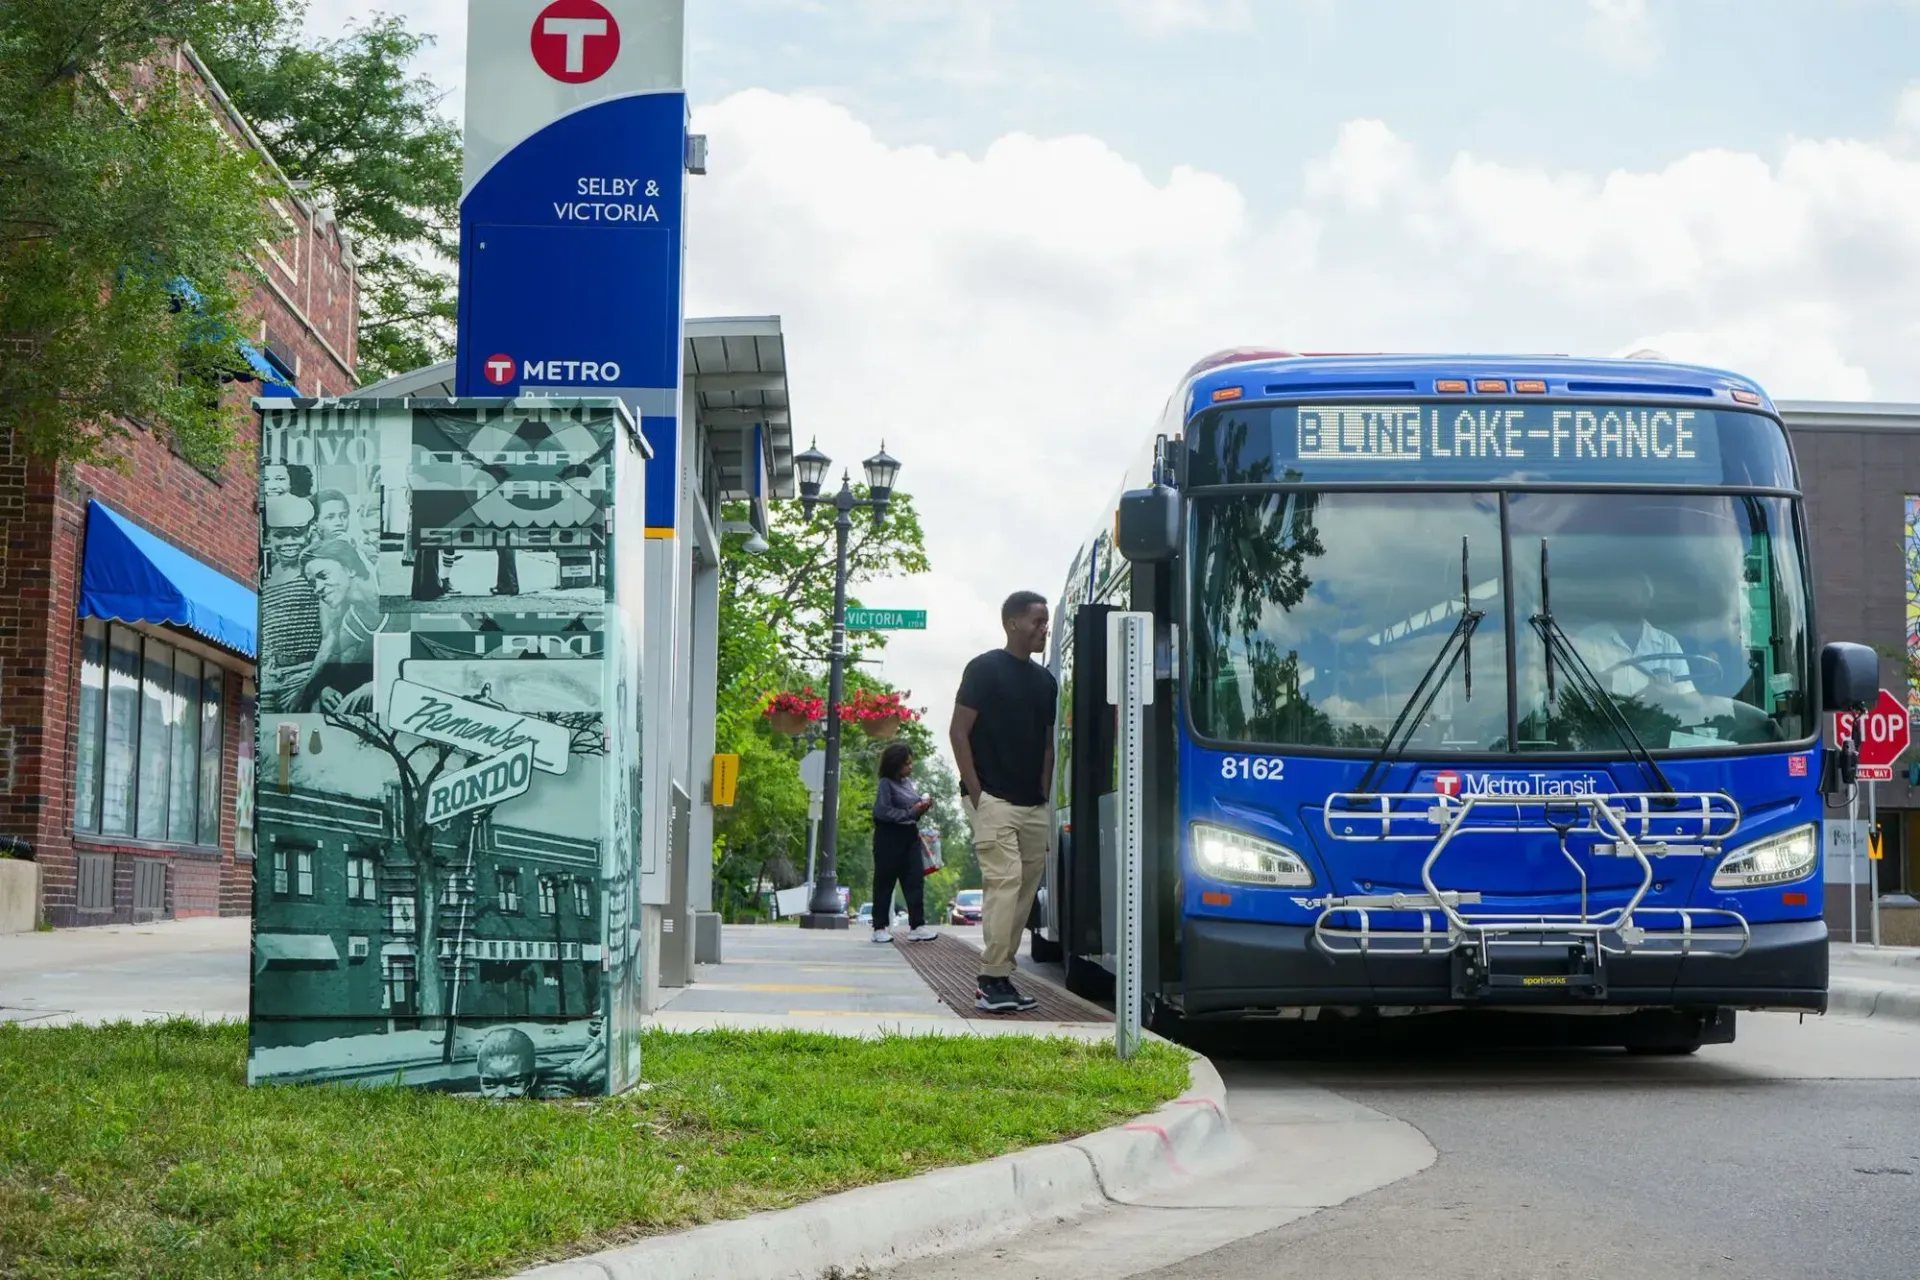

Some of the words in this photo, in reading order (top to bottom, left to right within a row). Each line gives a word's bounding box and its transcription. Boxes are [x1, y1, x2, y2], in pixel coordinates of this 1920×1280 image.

[543, 17, 607, 73] T
[577, 177, 640, 196] SELBY
[644, 179, 660, 197] &
[553, 202, 660, 222] VICTORIA
[523, 360, 620, 381] METRO
[1339, 413, 1419, 453] LINE
[1431, 409, 1696, 459] LAKE-FRANCE
[847, 611, 904, 626] VICTORIA
[502, 635, 591, 654] AM
[1840, 713, 1904, 743] STOP
[1221, 757, 1284, 780] 8162
[1873, 770, 1888, 778] WAY
[430, 752, 529, 819] RONDO
